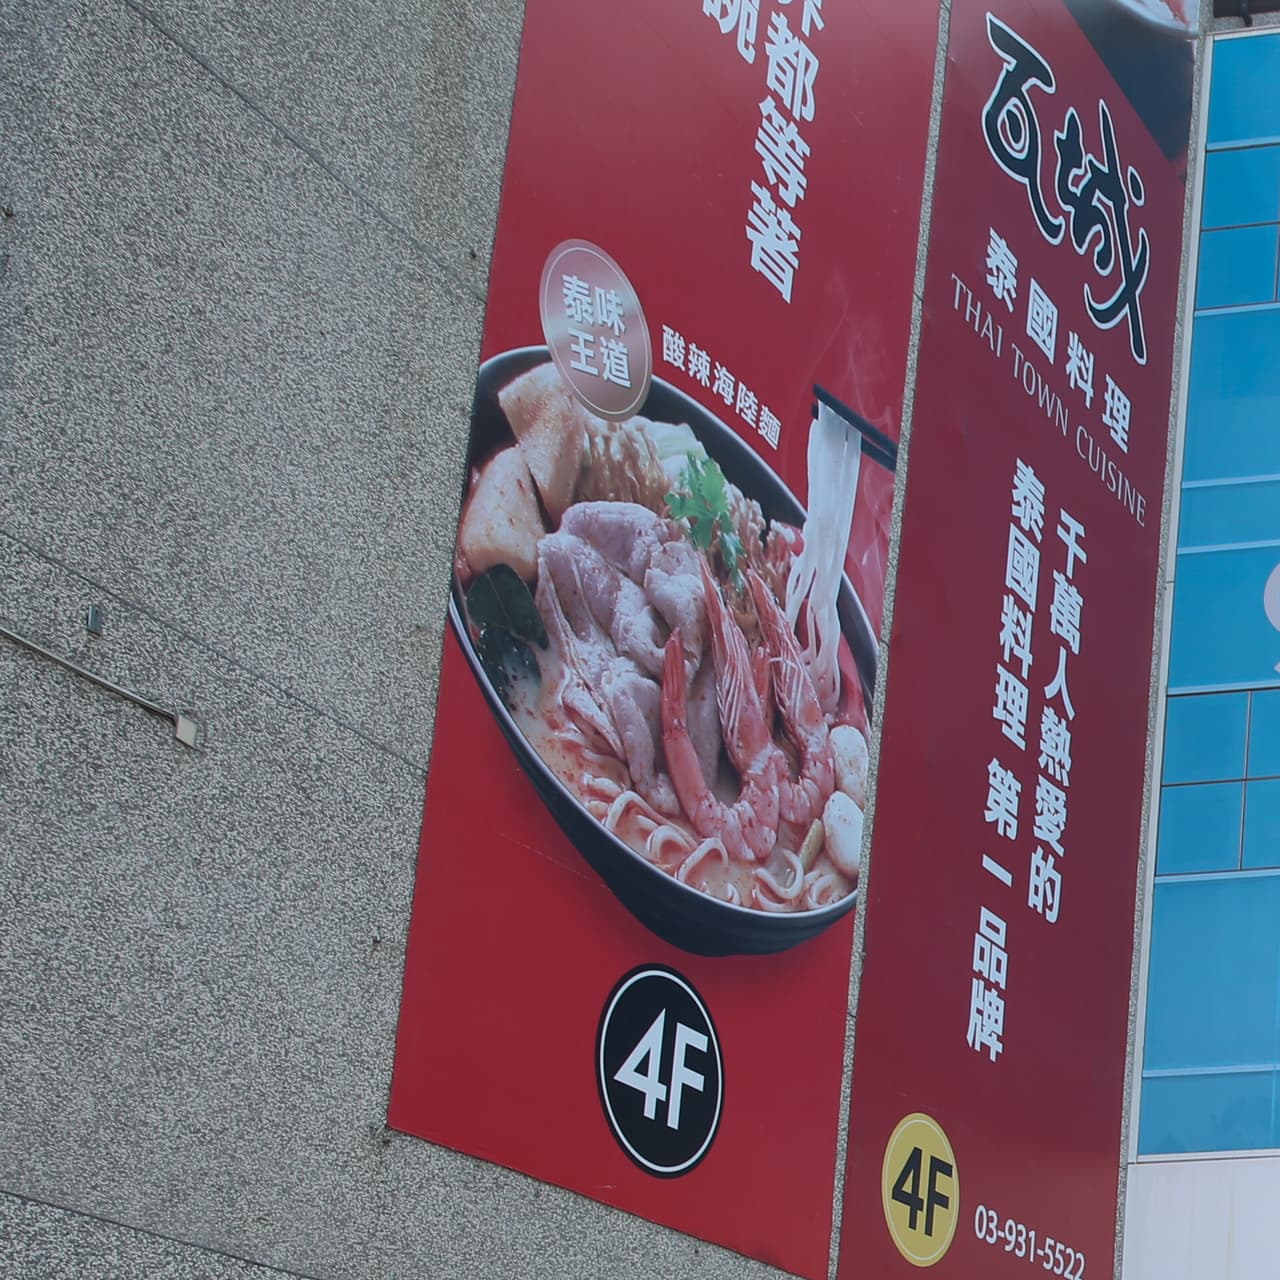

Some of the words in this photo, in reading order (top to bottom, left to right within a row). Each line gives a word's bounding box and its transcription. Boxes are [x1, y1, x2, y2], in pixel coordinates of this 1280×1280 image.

[745, 0, 825, 304] 都等著
[561, 274, 626, 336] 泰味
[567, 327, 632, 389] 王道
[986, 226, 1131, 454] 泰國料理
[951, 272, 1003, 358] THAI
[1010, 342, 1070, 436] TOWN
[1075, 424, 1147, 528] CUISINE
[1027, 507, 1088, 924] 千萬人熱愛的
[614, 1007, 709, 1131] 4F
[891, 1145, 954, 1238] 4F
